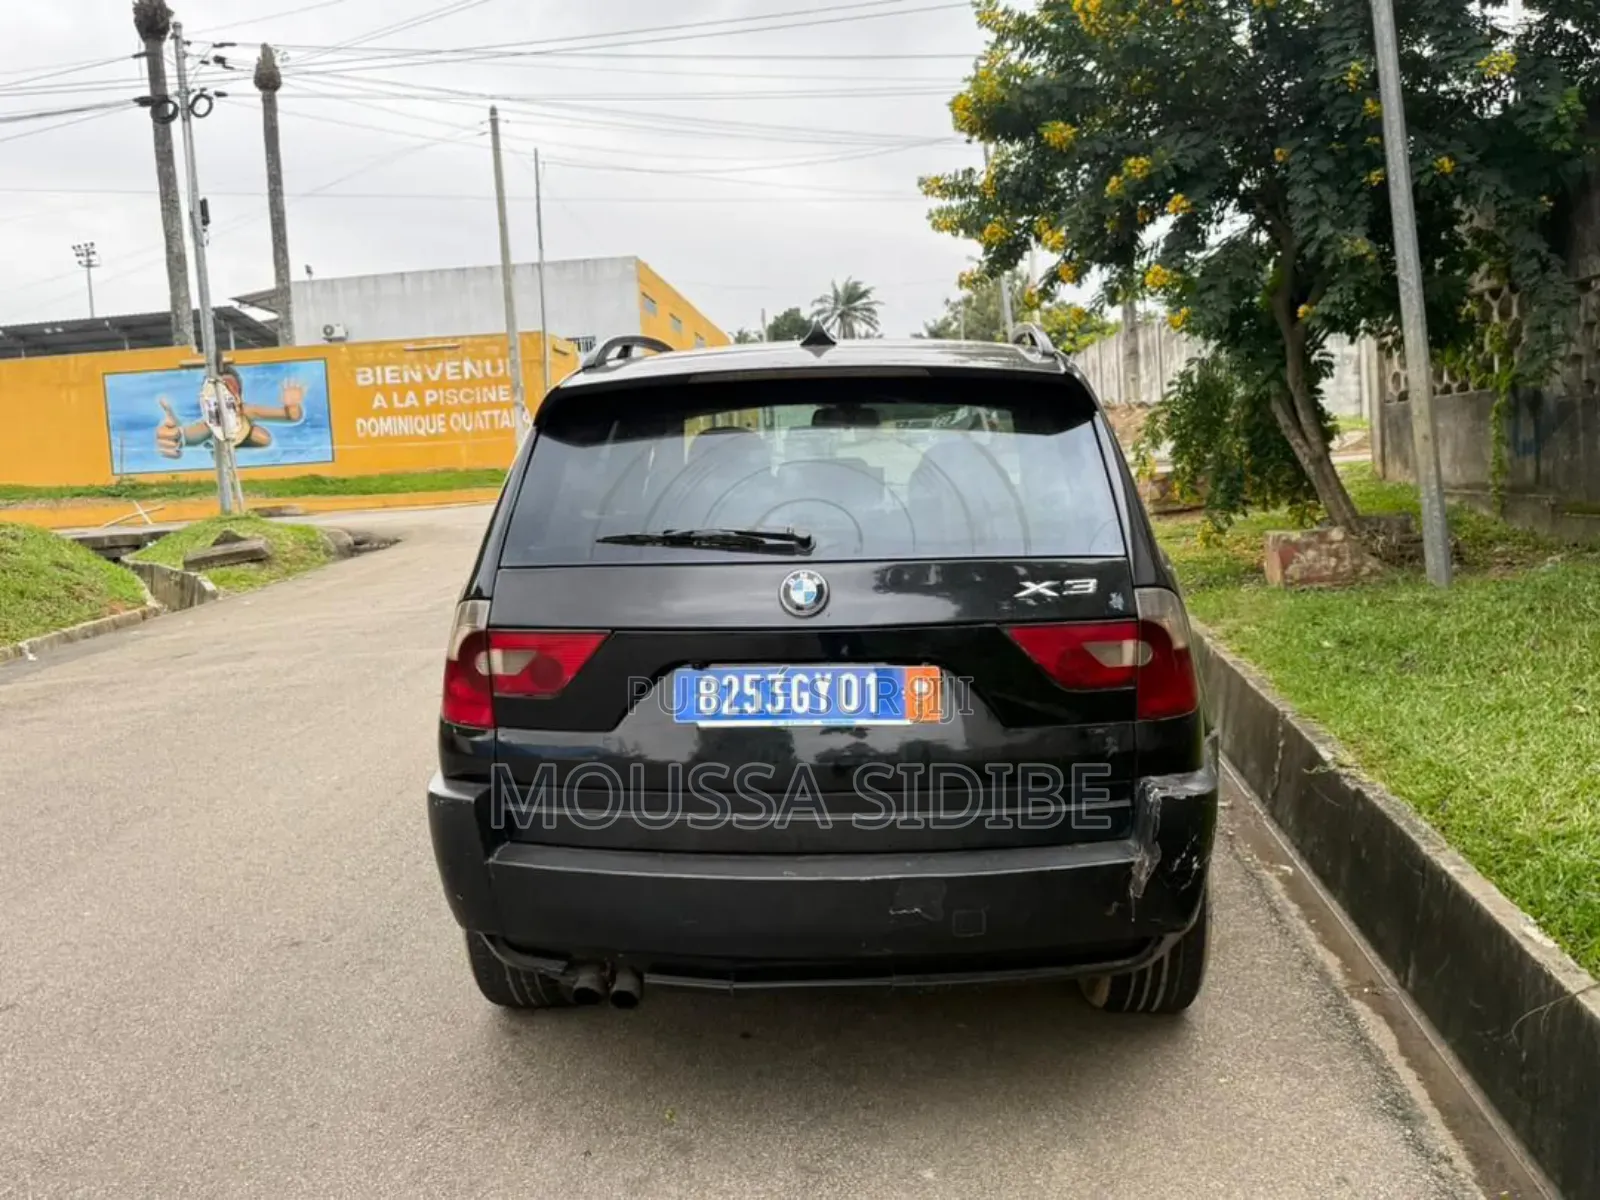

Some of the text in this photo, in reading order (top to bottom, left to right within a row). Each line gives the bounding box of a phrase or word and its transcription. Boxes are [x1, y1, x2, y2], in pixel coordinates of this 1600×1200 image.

[372, 384, 511, 409] A LA PISCINE
[355, 407, 533, 438] DOMINIQUE OUATTAA
[1014, 578, 1098, 597] X3
